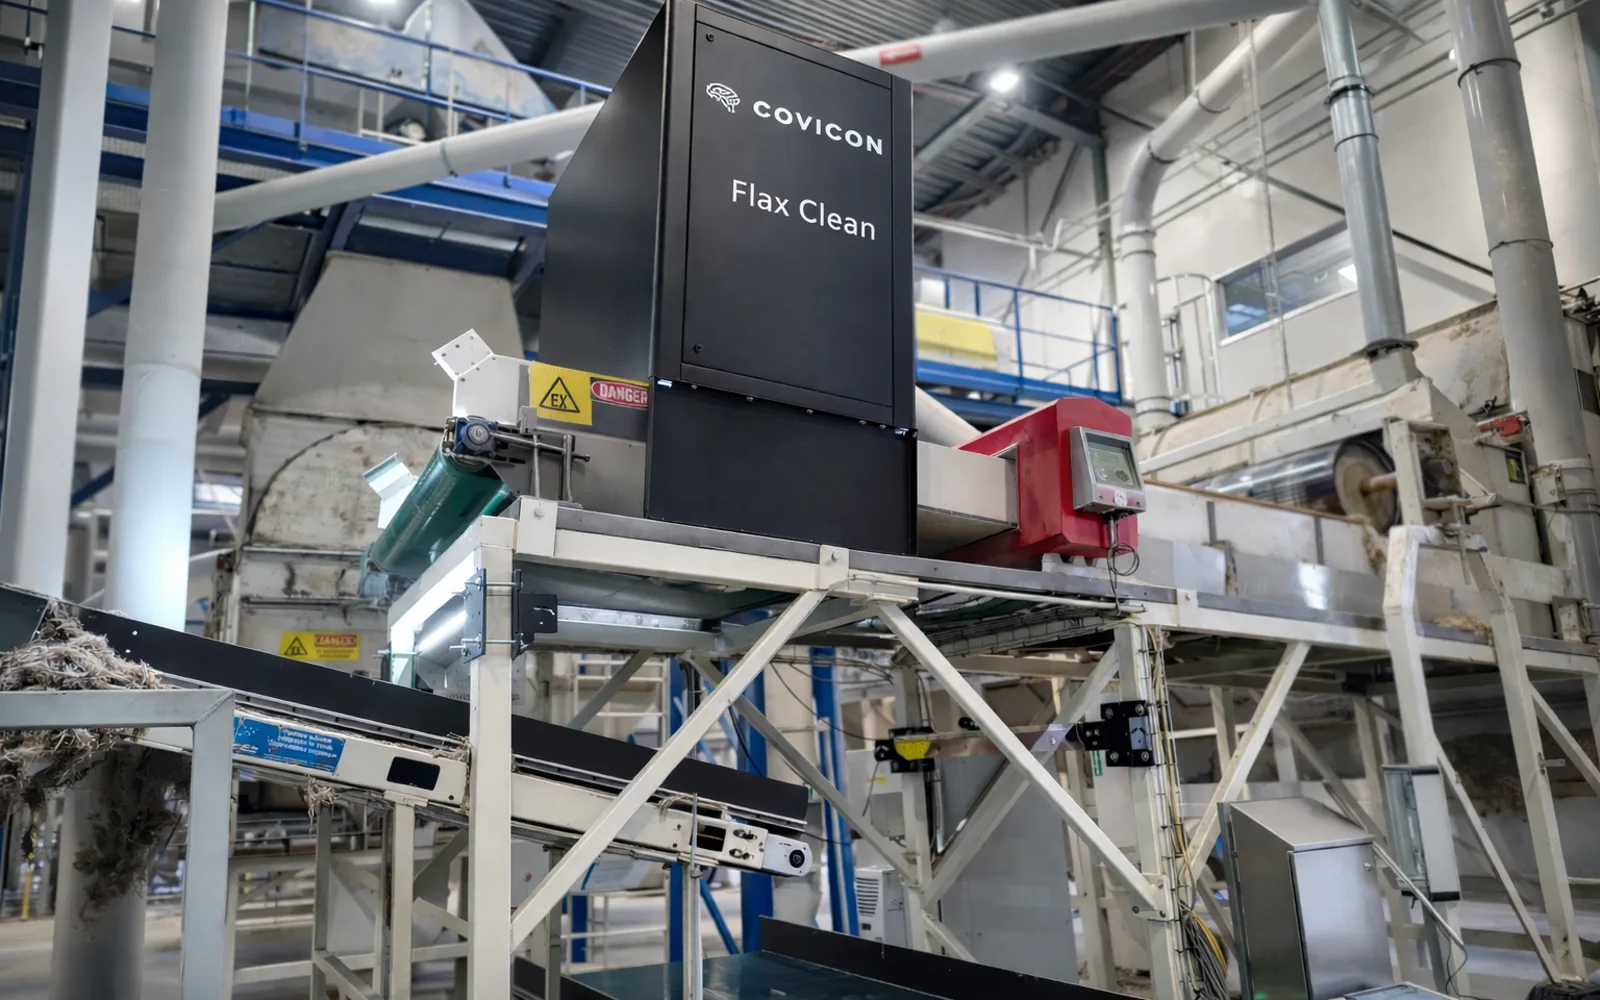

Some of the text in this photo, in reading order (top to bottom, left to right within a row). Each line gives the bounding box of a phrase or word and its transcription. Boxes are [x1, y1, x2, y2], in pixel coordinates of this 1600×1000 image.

[753, 100, 883, 155] COVICON
[732, 178, 876, 241] Flax Clean
[551, 393, 568, 409] EX
[599, 383, 648, 404] DANGER
